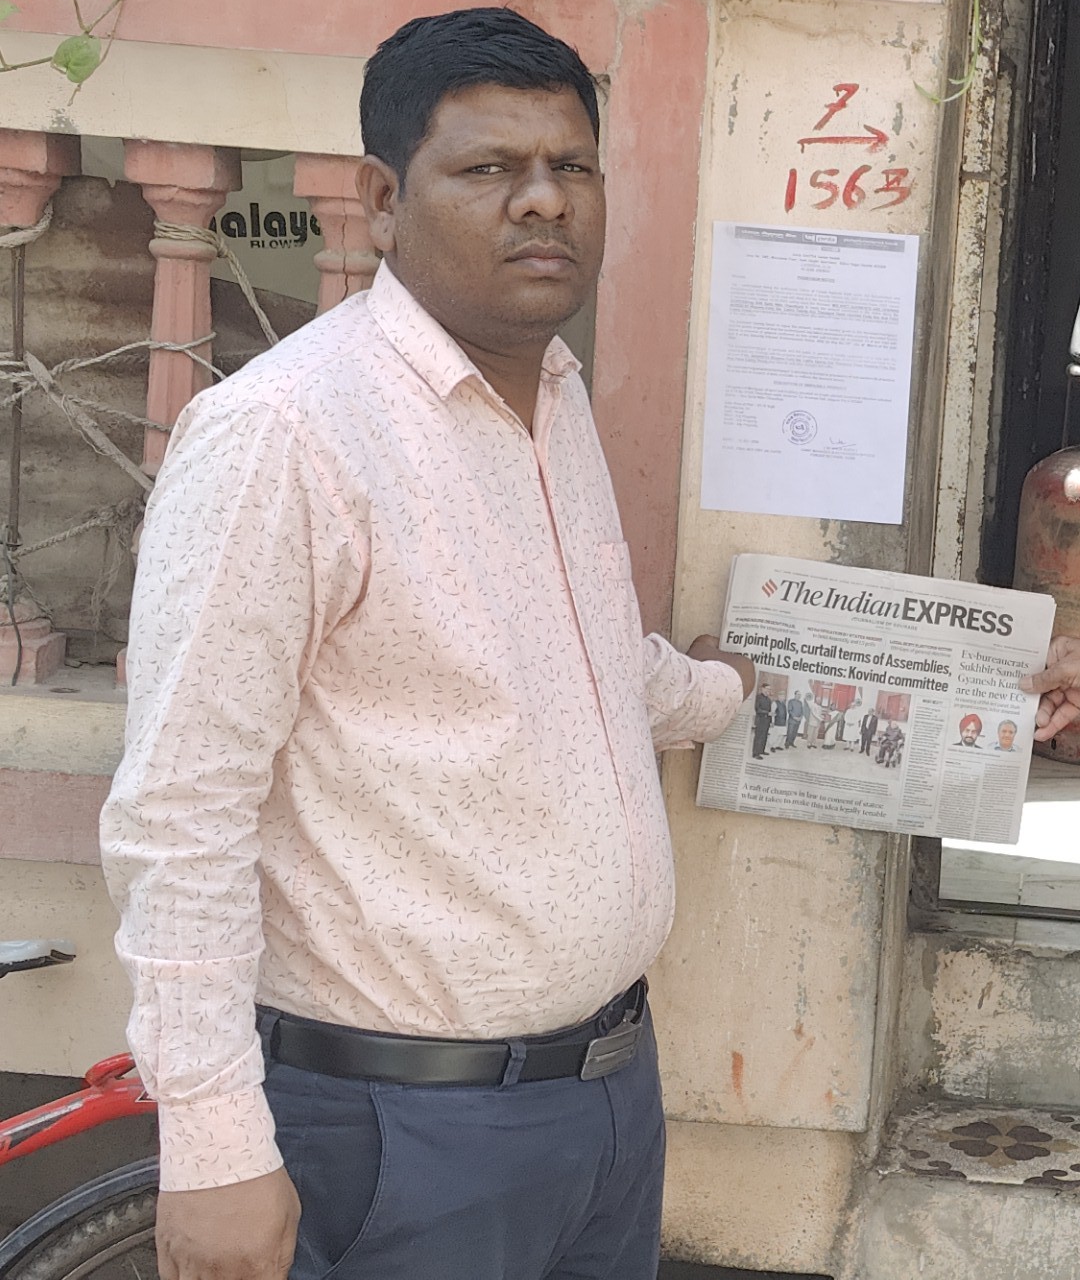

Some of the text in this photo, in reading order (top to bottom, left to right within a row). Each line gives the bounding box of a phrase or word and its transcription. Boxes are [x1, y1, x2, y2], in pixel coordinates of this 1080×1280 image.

[813, 83, 859, 131] 7
[780, 579, 823, 606] The
[822, 587, 900, 619] Indian
[902, 597, 1014, 637] EXPRESS
[726, 631, 743, 644] For
[743, 632, 769, 648] joint
[769, 637, 799, 654] polls,
[800, 643, 838, 659] curtail
[838, 649, 871, 663] terms
[872, 652, 885, 666] of
[885, 654, 952, 677] Assemblies,
[959, 661, 996, 675] Sukhbir
[961, 649, 1029, 669] Ex-bureaucrats
[751, 651, 949, 693] with LS elections: Kovind committee
[957, 673, 996, 686] Gyanesh
[955, 687, 970, 696] are
[971, 688, 987, 698] the
[988, 691, 1007, 700] new
